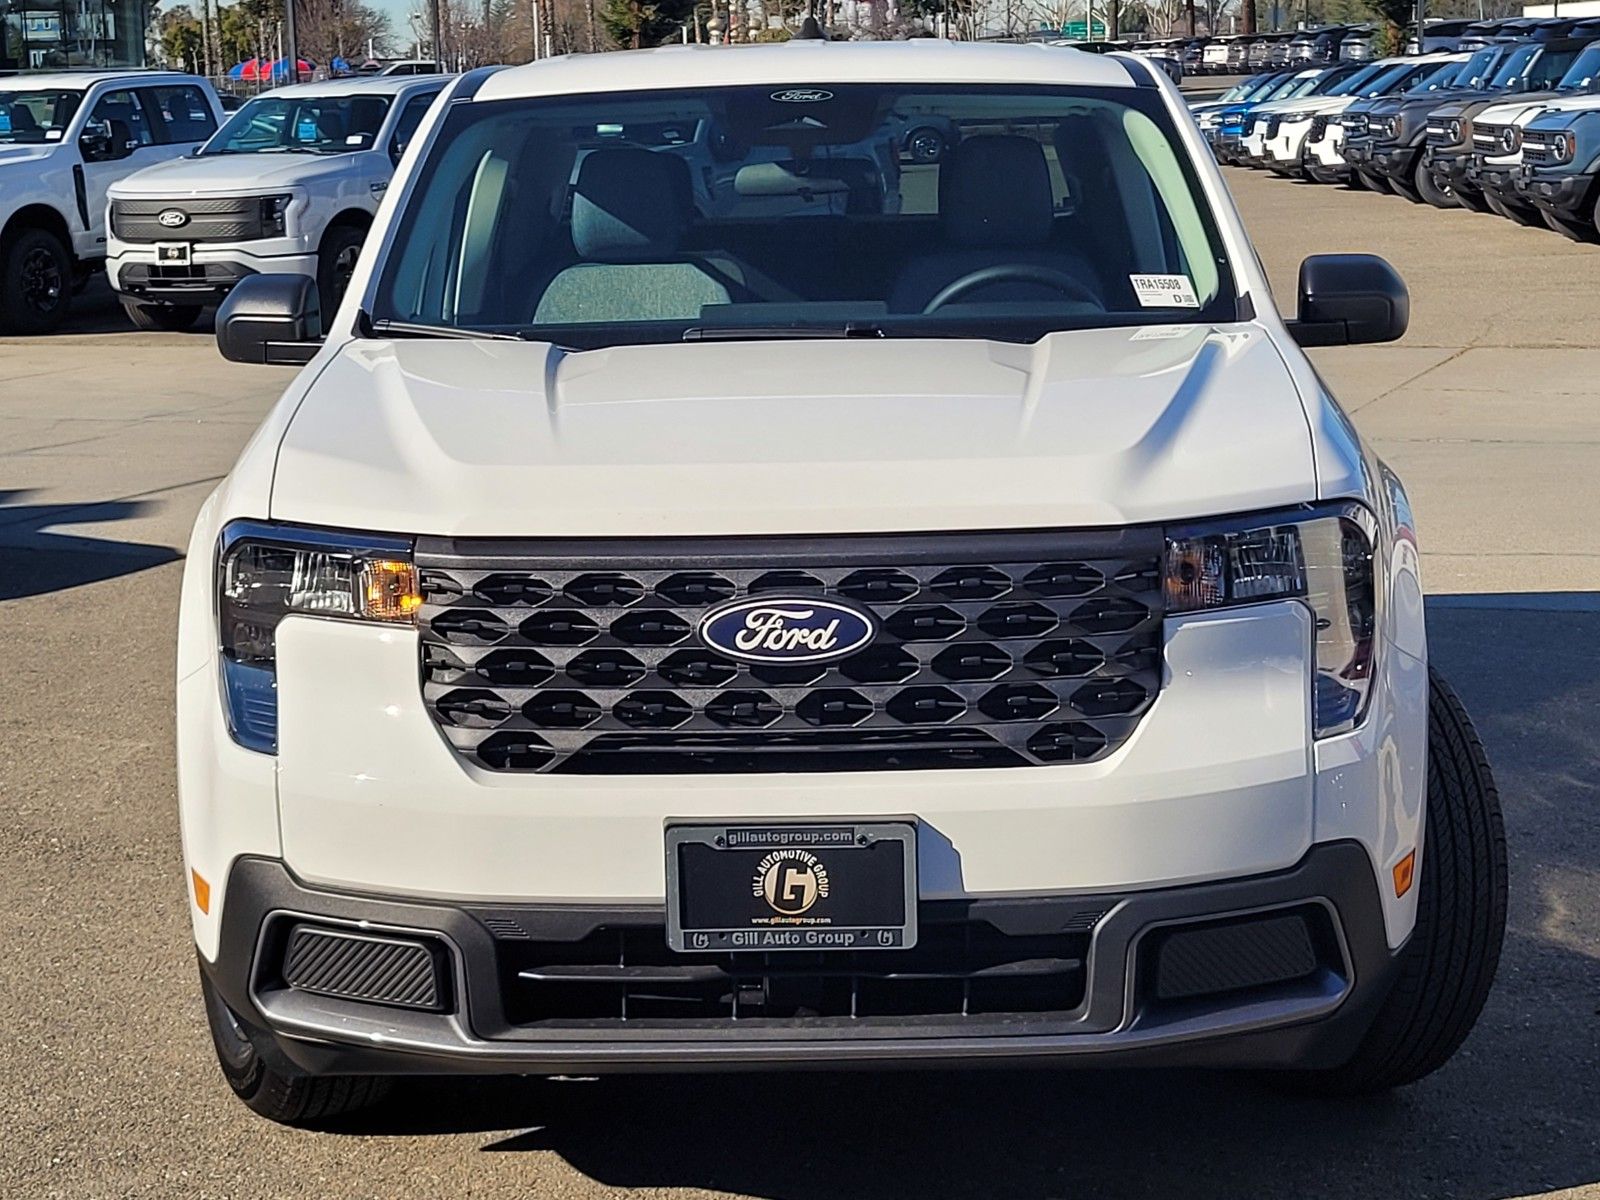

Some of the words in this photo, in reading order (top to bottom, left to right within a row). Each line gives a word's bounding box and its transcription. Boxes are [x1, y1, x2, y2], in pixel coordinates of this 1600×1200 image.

[781, 90, 822, 100] Ford
[1173, 294, 1182, 303] D
[734, 608, 841, 651] Ford
[728, 831, 853, 845] gillautogroup.com
[756, 849, 818, 875] AUTOMOTIVE
[751, 874, 765, 897] GILL
[813, 864, 830, 898] GROUP
[751, 916, 832, 925] www.gillautogroup.com
[731, 932, 759, 945] Gill
[762, 931, 801, 945] Auto
[806, 931, 855, 946] Group
